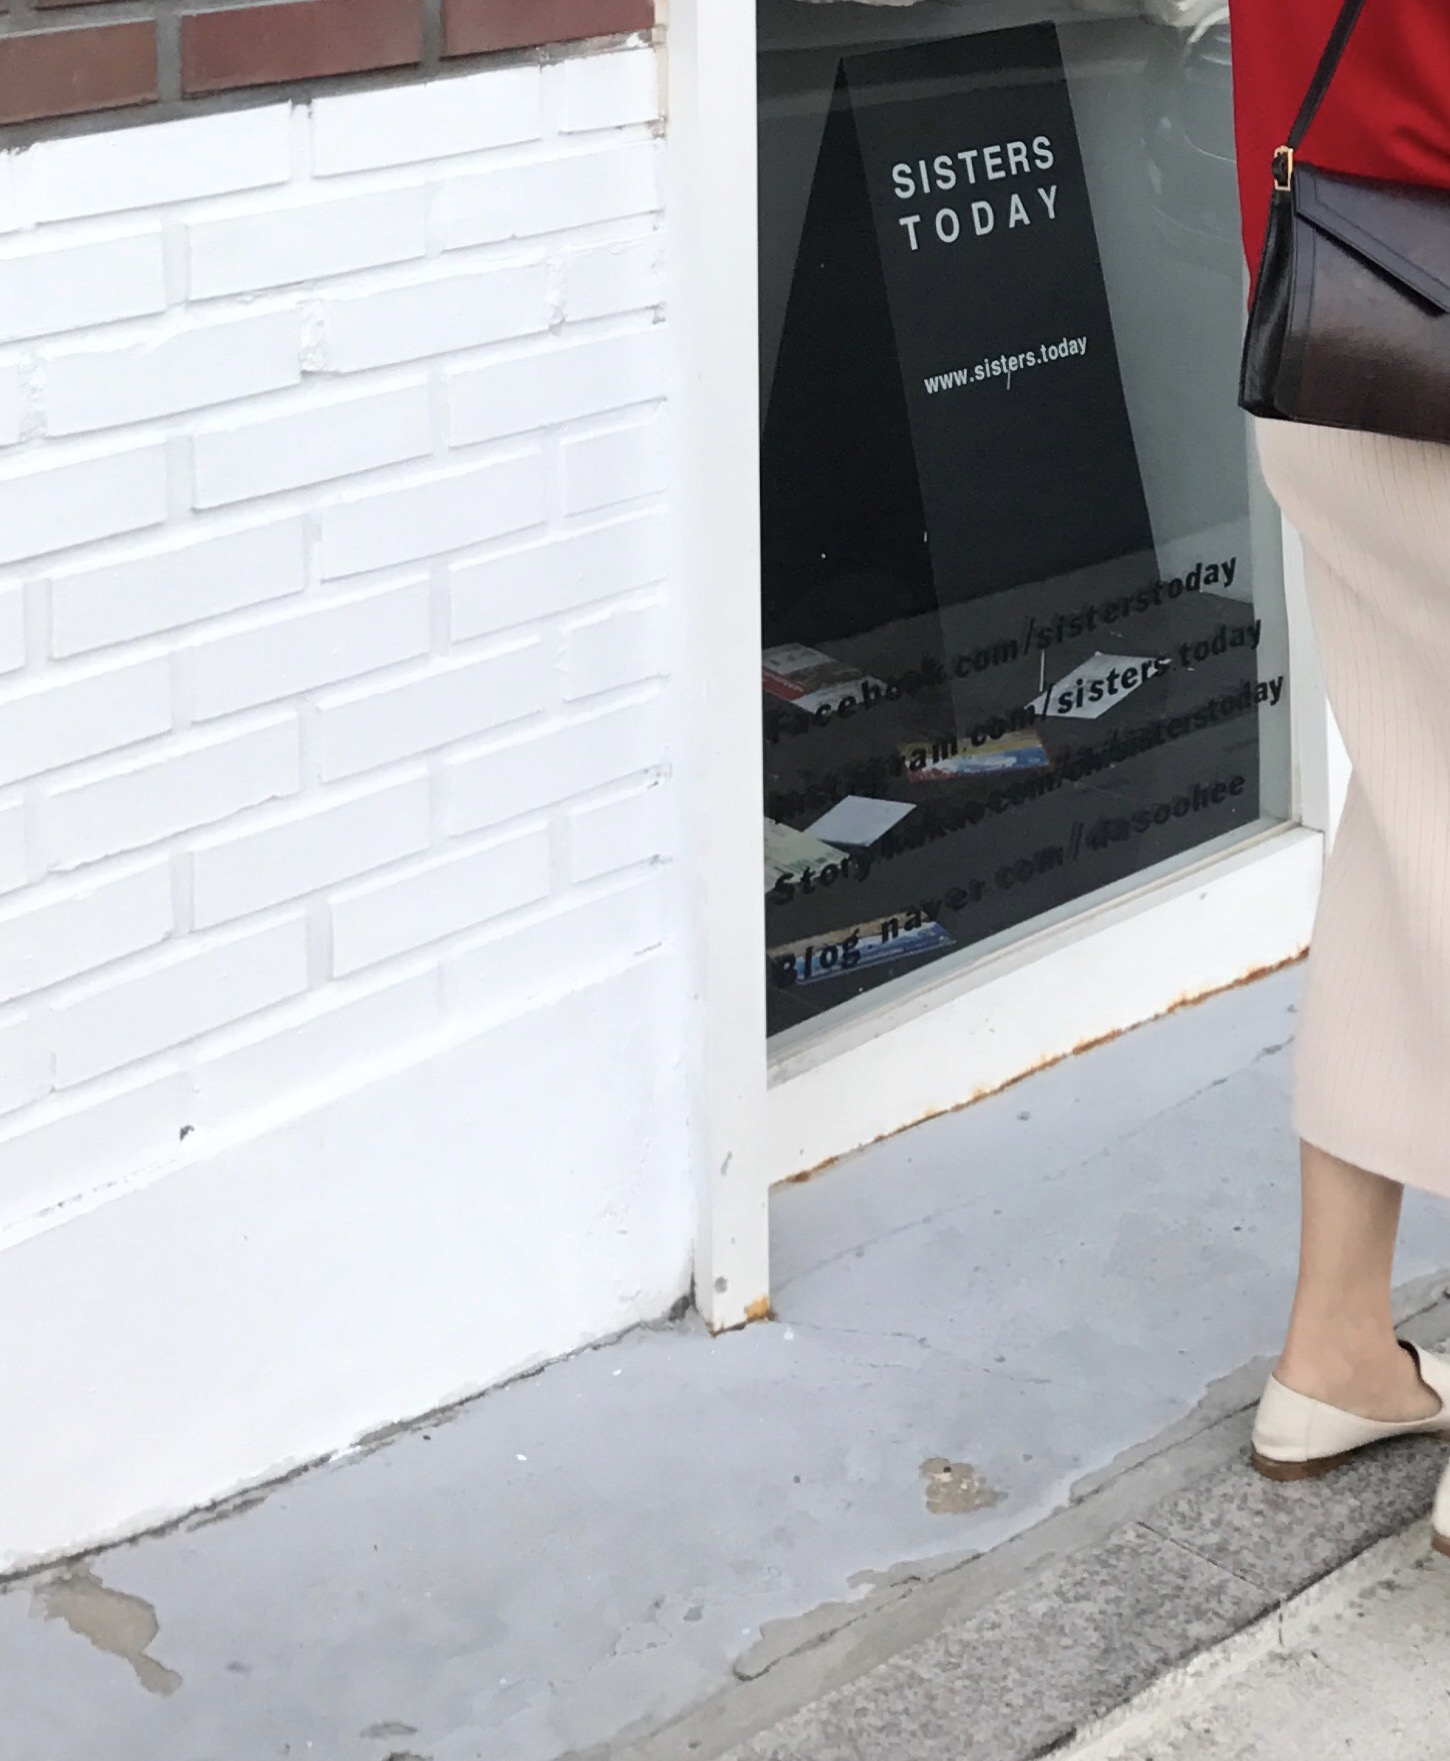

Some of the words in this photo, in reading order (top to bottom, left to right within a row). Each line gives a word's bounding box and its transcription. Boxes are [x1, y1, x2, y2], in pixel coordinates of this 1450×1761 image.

[892, 135, 1055, 199] SISTERS
[899, 185, 1057, 251] TODAY
[924, 336, 1087, 394] www.sisters.today
